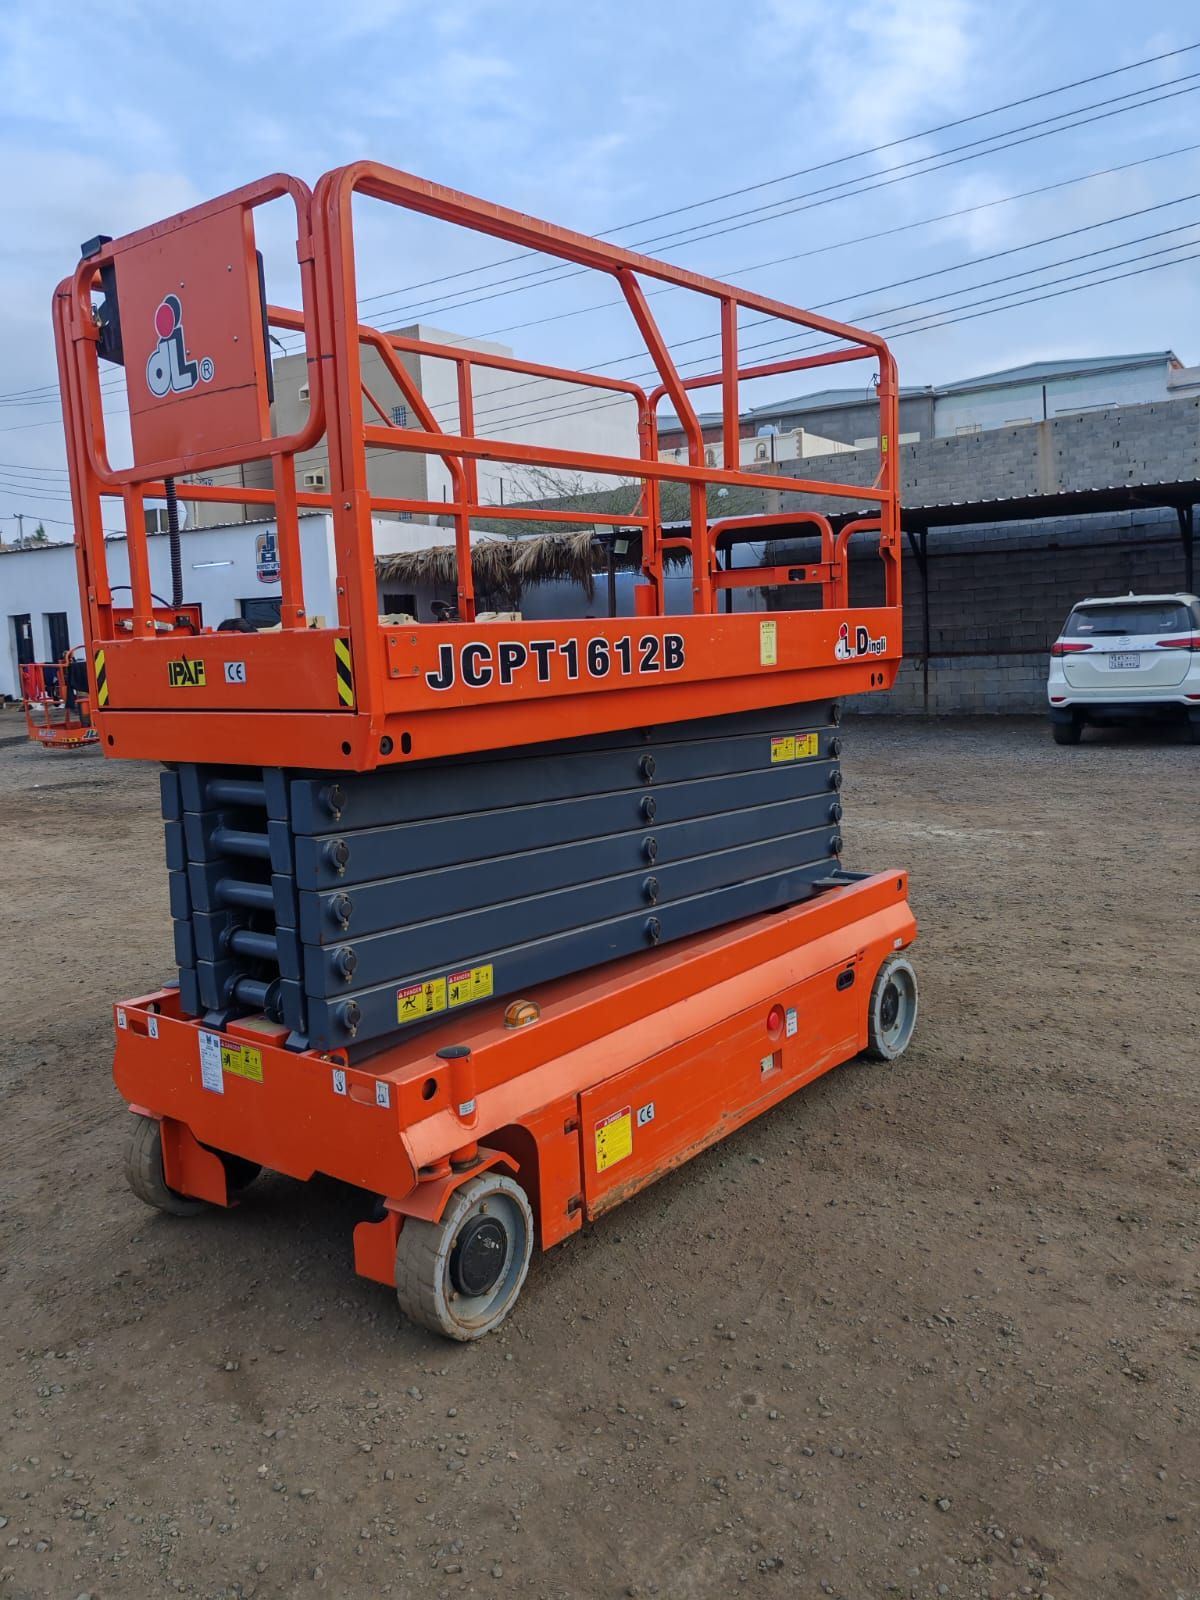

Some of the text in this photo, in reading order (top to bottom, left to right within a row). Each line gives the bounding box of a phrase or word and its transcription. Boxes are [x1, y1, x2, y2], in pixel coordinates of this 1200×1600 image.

[856, 626, 886, 656] Dingli
[168, 654, 204, 685] IPAF
[227, 663, 243, 681] CE
[425, 633, 685, 691] JCPT1612B
[639, 1104, 652, 1123] CE
